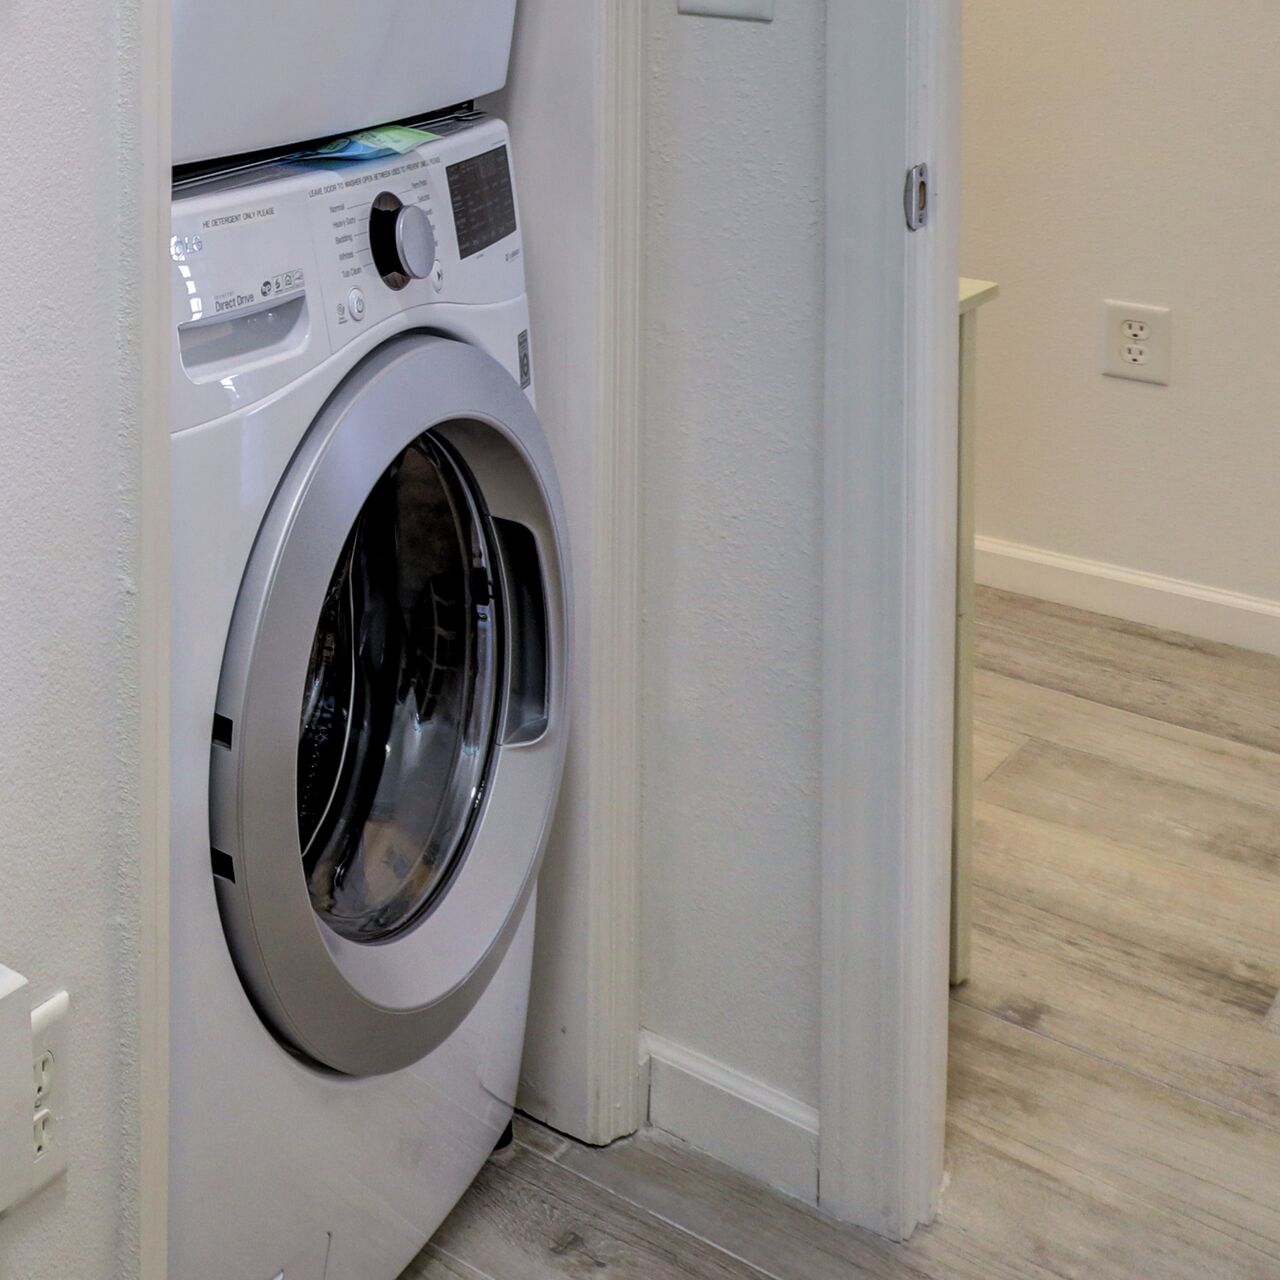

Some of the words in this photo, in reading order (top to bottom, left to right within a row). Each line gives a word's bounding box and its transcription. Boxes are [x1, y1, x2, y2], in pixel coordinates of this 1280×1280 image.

[202, 219, 211, 229] HE
[211, 214, 241, 227] DETERGENT
[242, 210, 256, 220] ONLY
[256, 207, 275, 217] PLEASE
[214, 298, 237, 312] Direct
[236, 293, 255, 306] Drive
